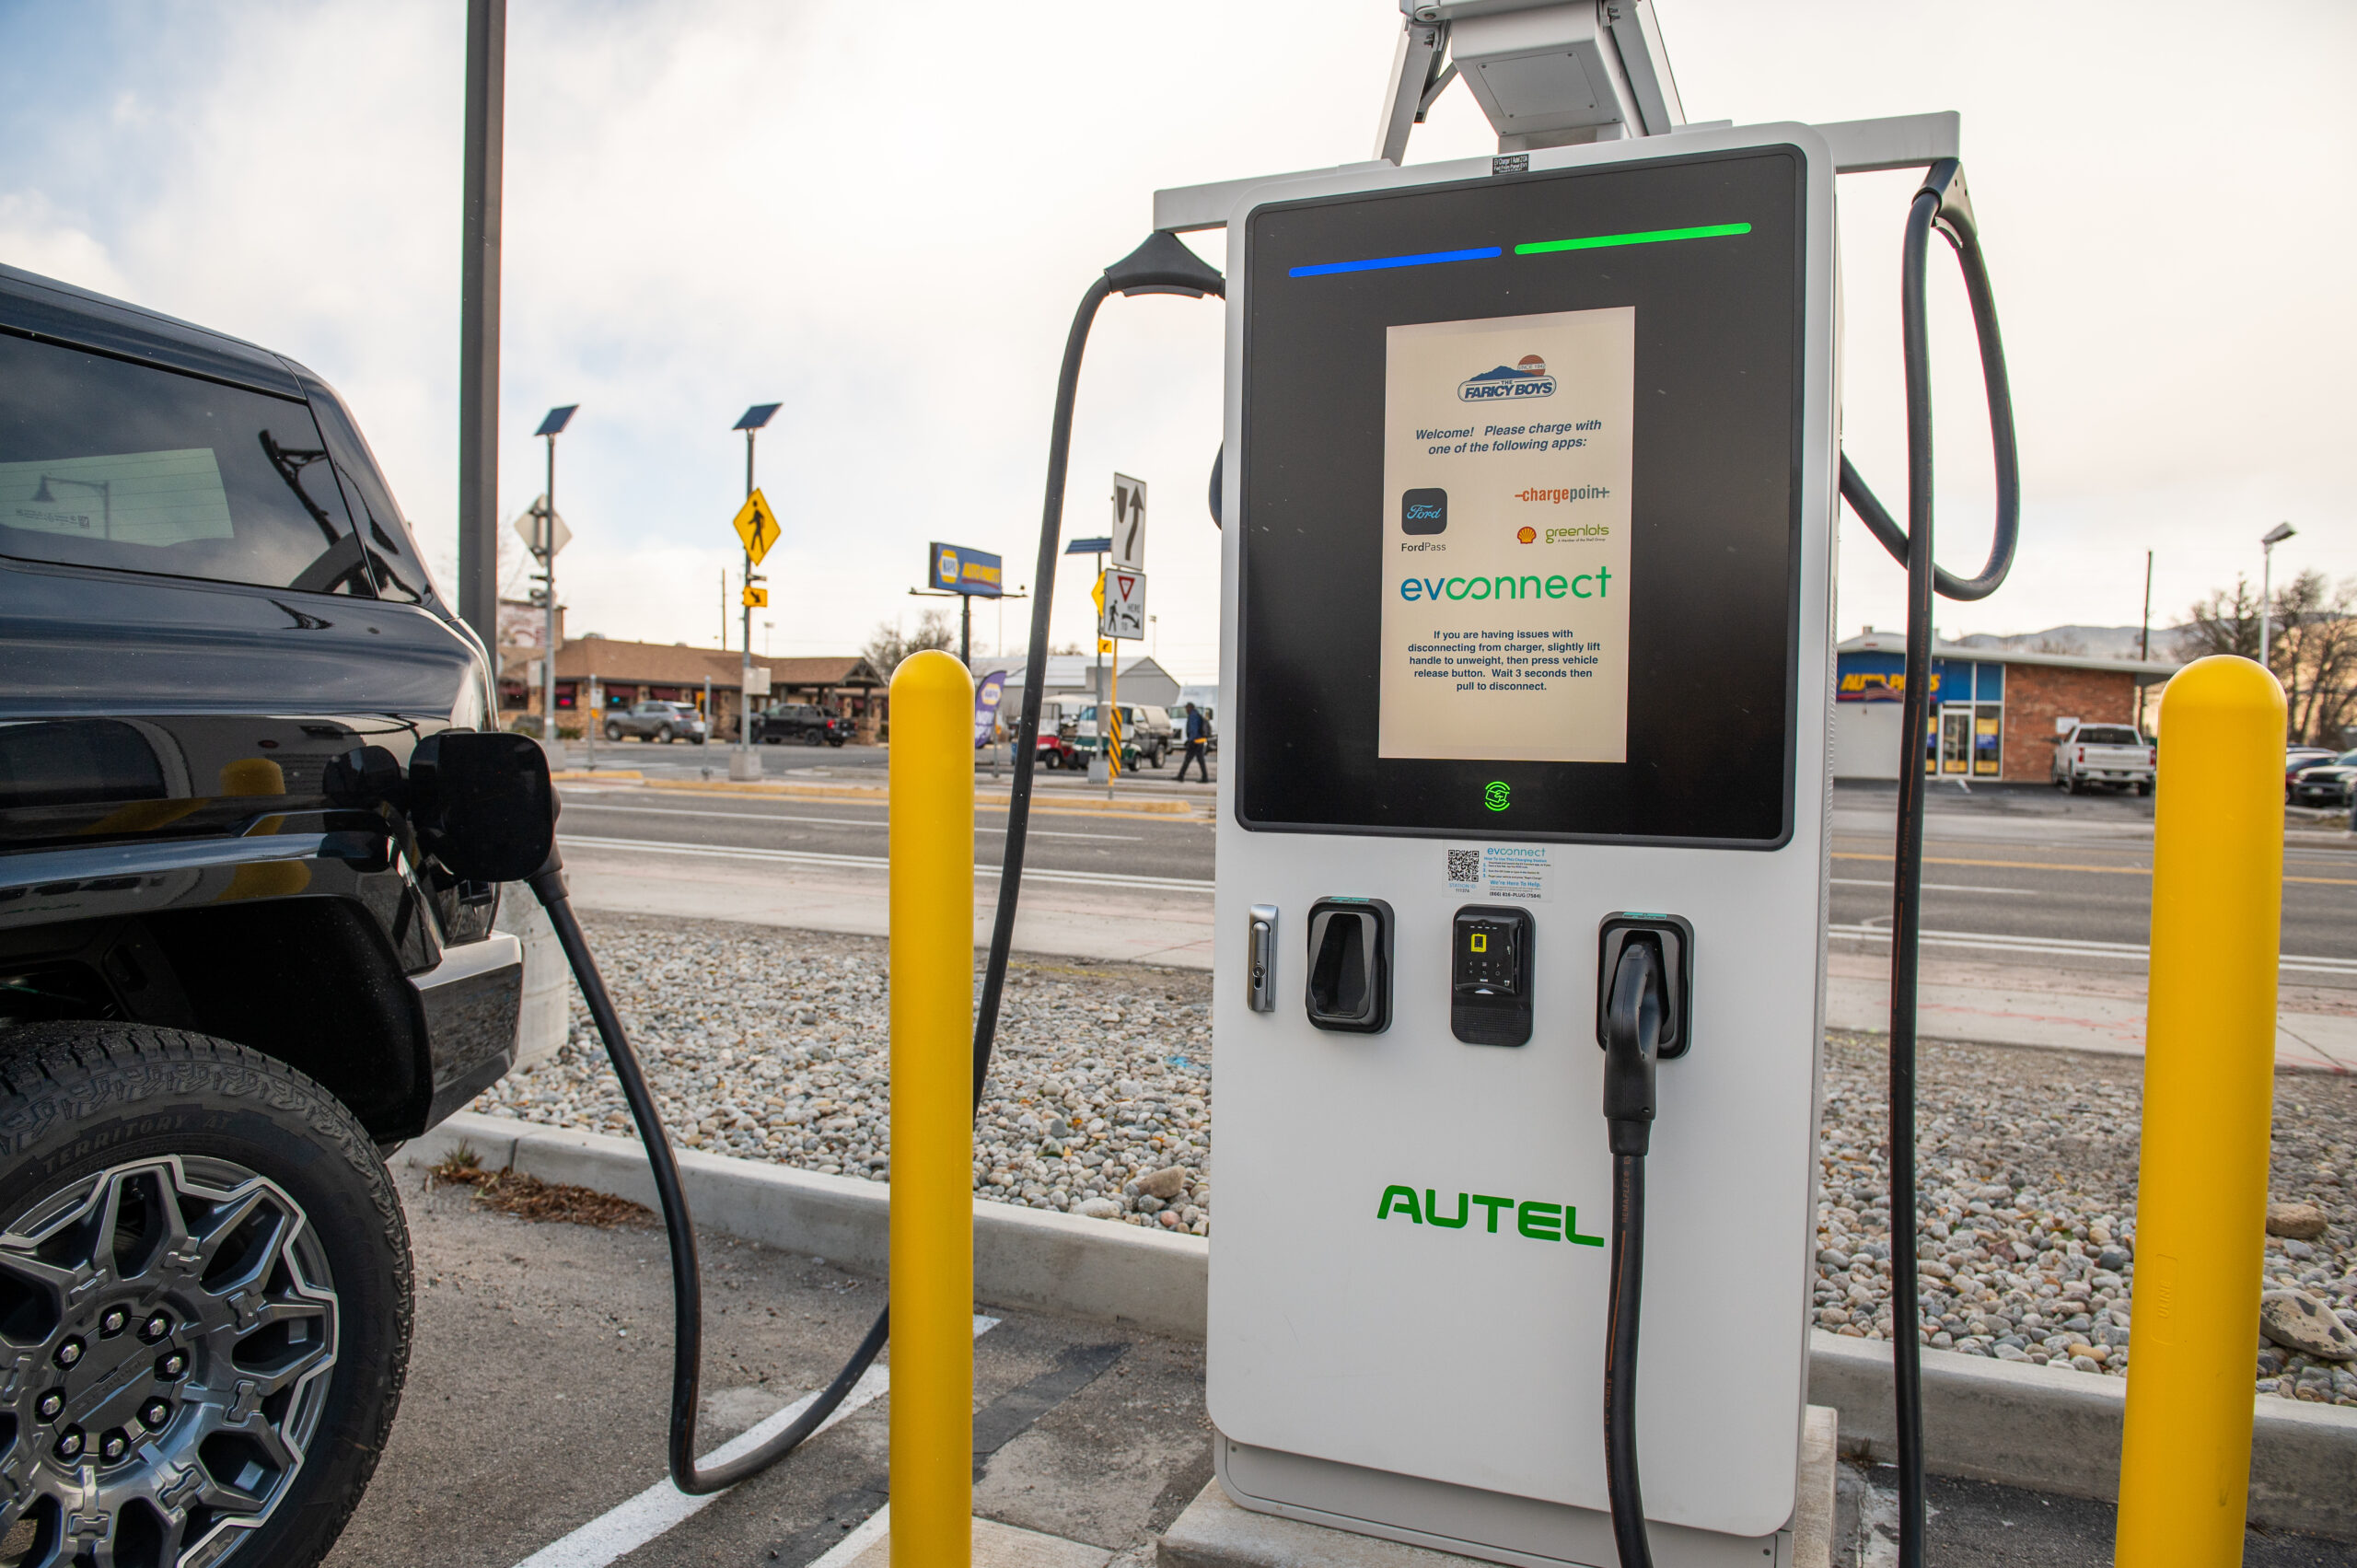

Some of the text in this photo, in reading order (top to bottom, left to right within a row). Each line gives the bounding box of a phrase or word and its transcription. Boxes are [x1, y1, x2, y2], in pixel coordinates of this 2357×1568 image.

[1465, 382, 1552, 399] FARICY BOYS
[1415, 419, 1602, 440] Welcome! Please charge with
[1428, 438, 1587, 455] one of the following apps:
[1406, 505, 1442, 519] Ford
[1545, 524, 1609, 544] greenlots
[1401, 541, 1446, 552] FordPass
[1400, 566, 1611, 601] evconnect
[1127, 603, 1141, 613] HERE
[1120, 621, 1128, 632] TO
[1434, 630, 1441, 639] If
[1443, 632, 1460, 642] you
[1481, 630, 1514, 641] having
[1517, 629, 1549, 639] issues
[1552, 629, 1573, 638] with
[1408, 642, 1600, 654] disconnecting from charger, slightly lift
[1409, 656, 1598, 667] handle to unweight, then press vehicle
[1413, 668, 1593, 678] release button. Wait 3 seconds then
[1457, 681, 1547, 692] pull to disconnect.
[1487, 847, 1546, 856] evconnect
[42, 1113, 189, 1173] TERRITORY
[1376, 1184, 1604, 1248] AUTEL
